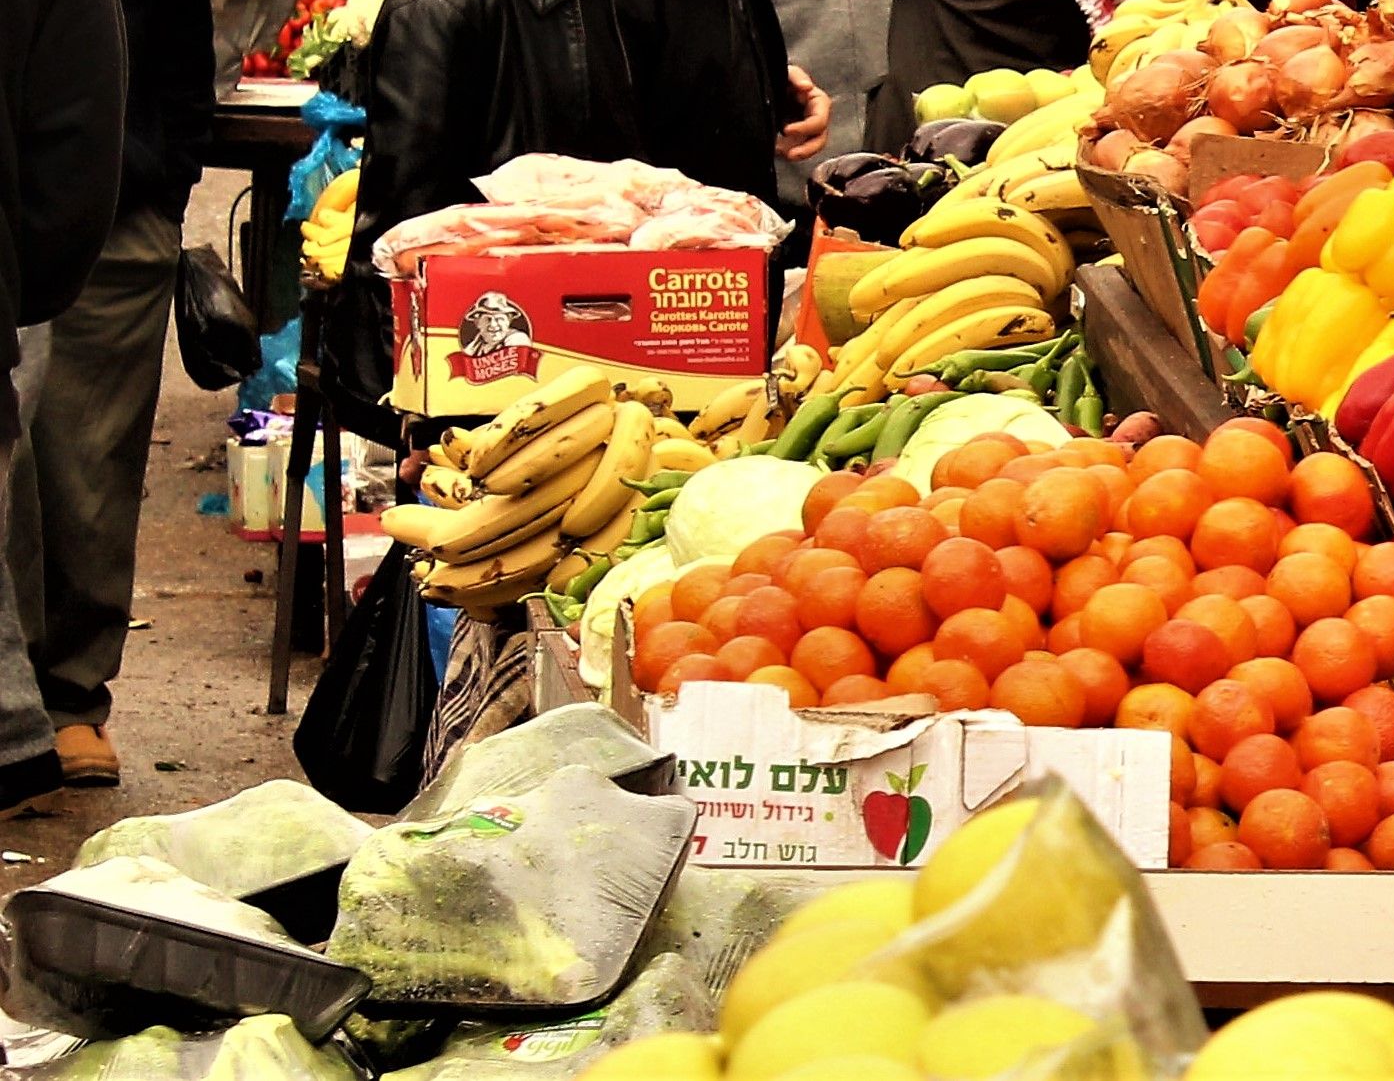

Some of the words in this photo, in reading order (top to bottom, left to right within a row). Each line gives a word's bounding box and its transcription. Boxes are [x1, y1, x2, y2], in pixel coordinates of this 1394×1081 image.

[648, 268, 749, 290] Carrots
[649, 290, 713, 308] מובחר
[717, 290, 749, 307] גזר
[472, 346, 519, 369] UNCLE
[474, 358, 519, 381] MOSES
[769, 758, 848, 795] עלם
[762, 800, 814, 822] גידול
[722, 837, 768, 861] חלב
[777, 843, 818, 863] גוש
